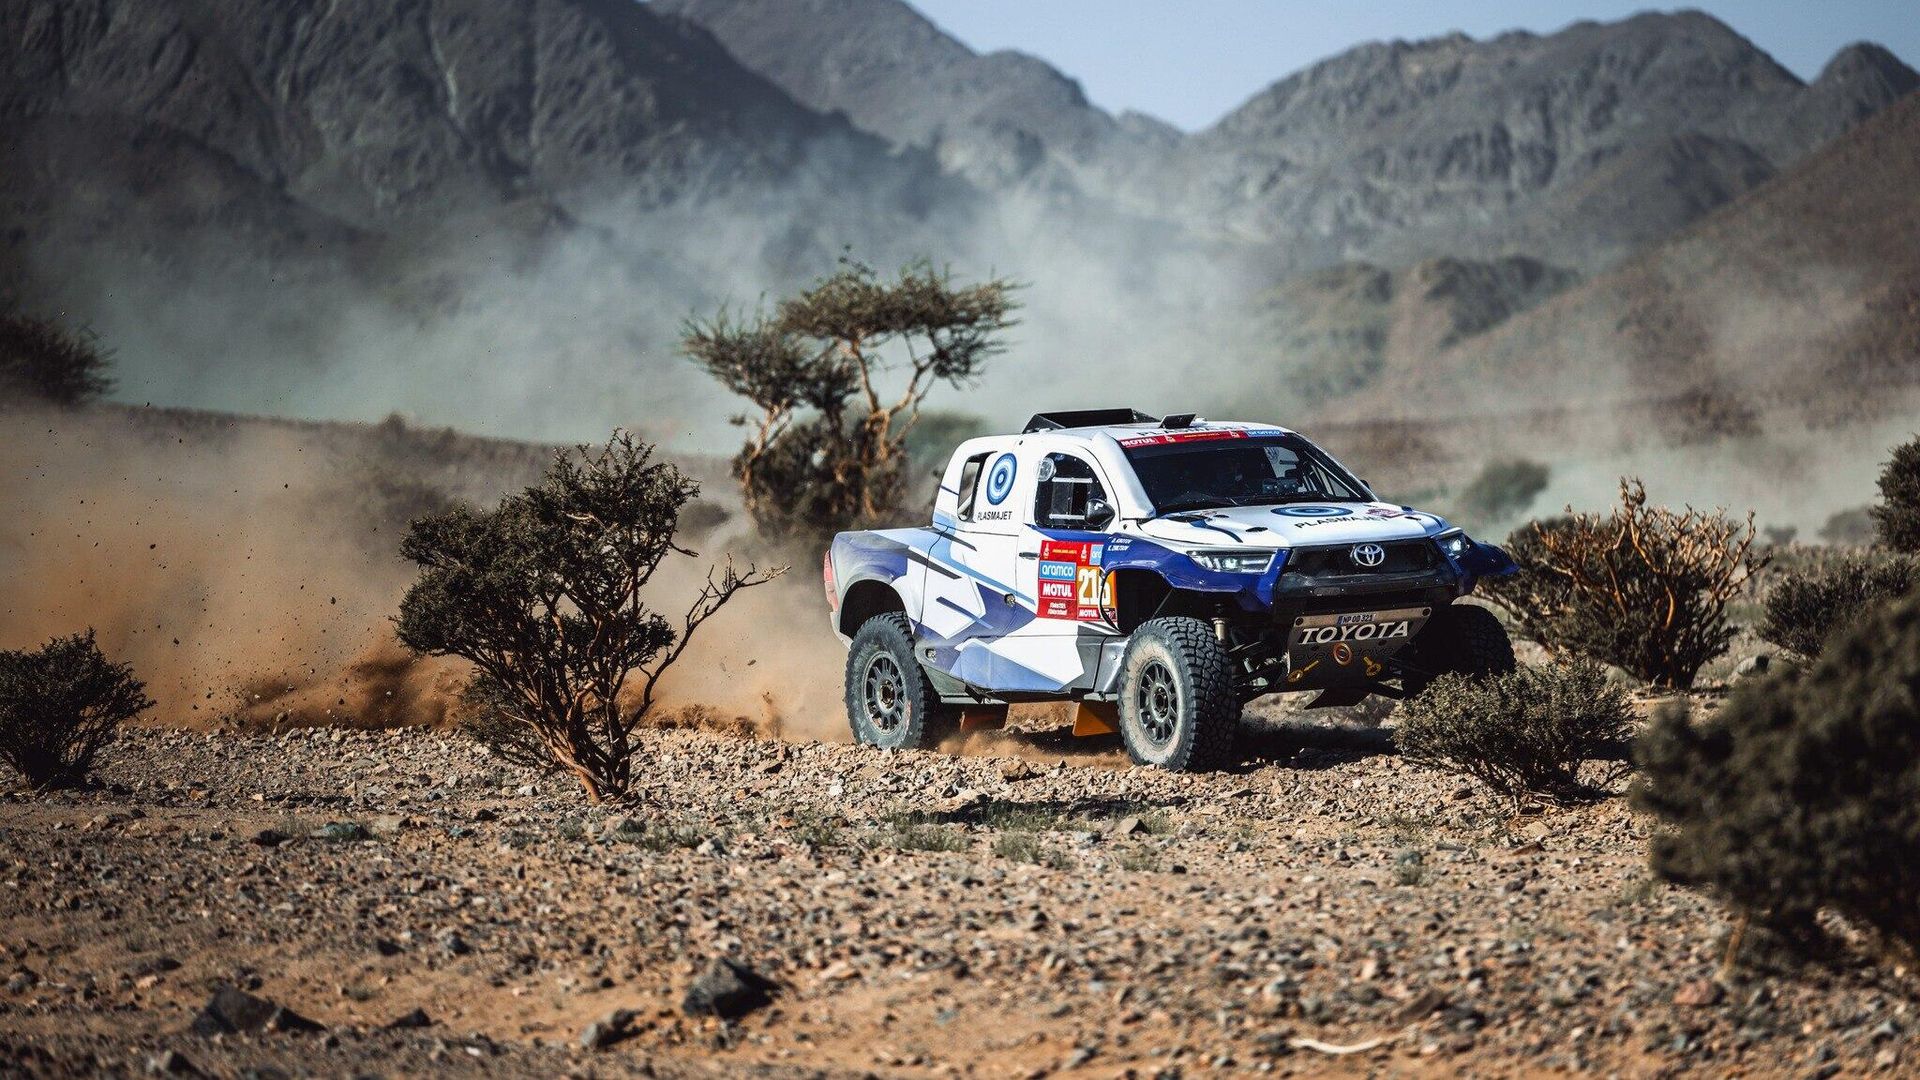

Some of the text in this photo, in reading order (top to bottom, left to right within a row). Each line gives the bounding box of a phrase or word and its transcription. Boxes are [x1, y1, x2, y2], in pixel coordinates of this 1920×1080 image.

[1121, 437, 1156, 447] MOTUL
[977, 511, 1013, 521] PLASMAJET
[1295, 516, 1388, 528] PLASMAJET
[1042, 564, 1073, 577] aramco
[1042, 583, 1072, 597] MOTUL
[1079, 609, 1098, 618] MOTUL
[1301, 621, 1408, 645] TOYOTA
